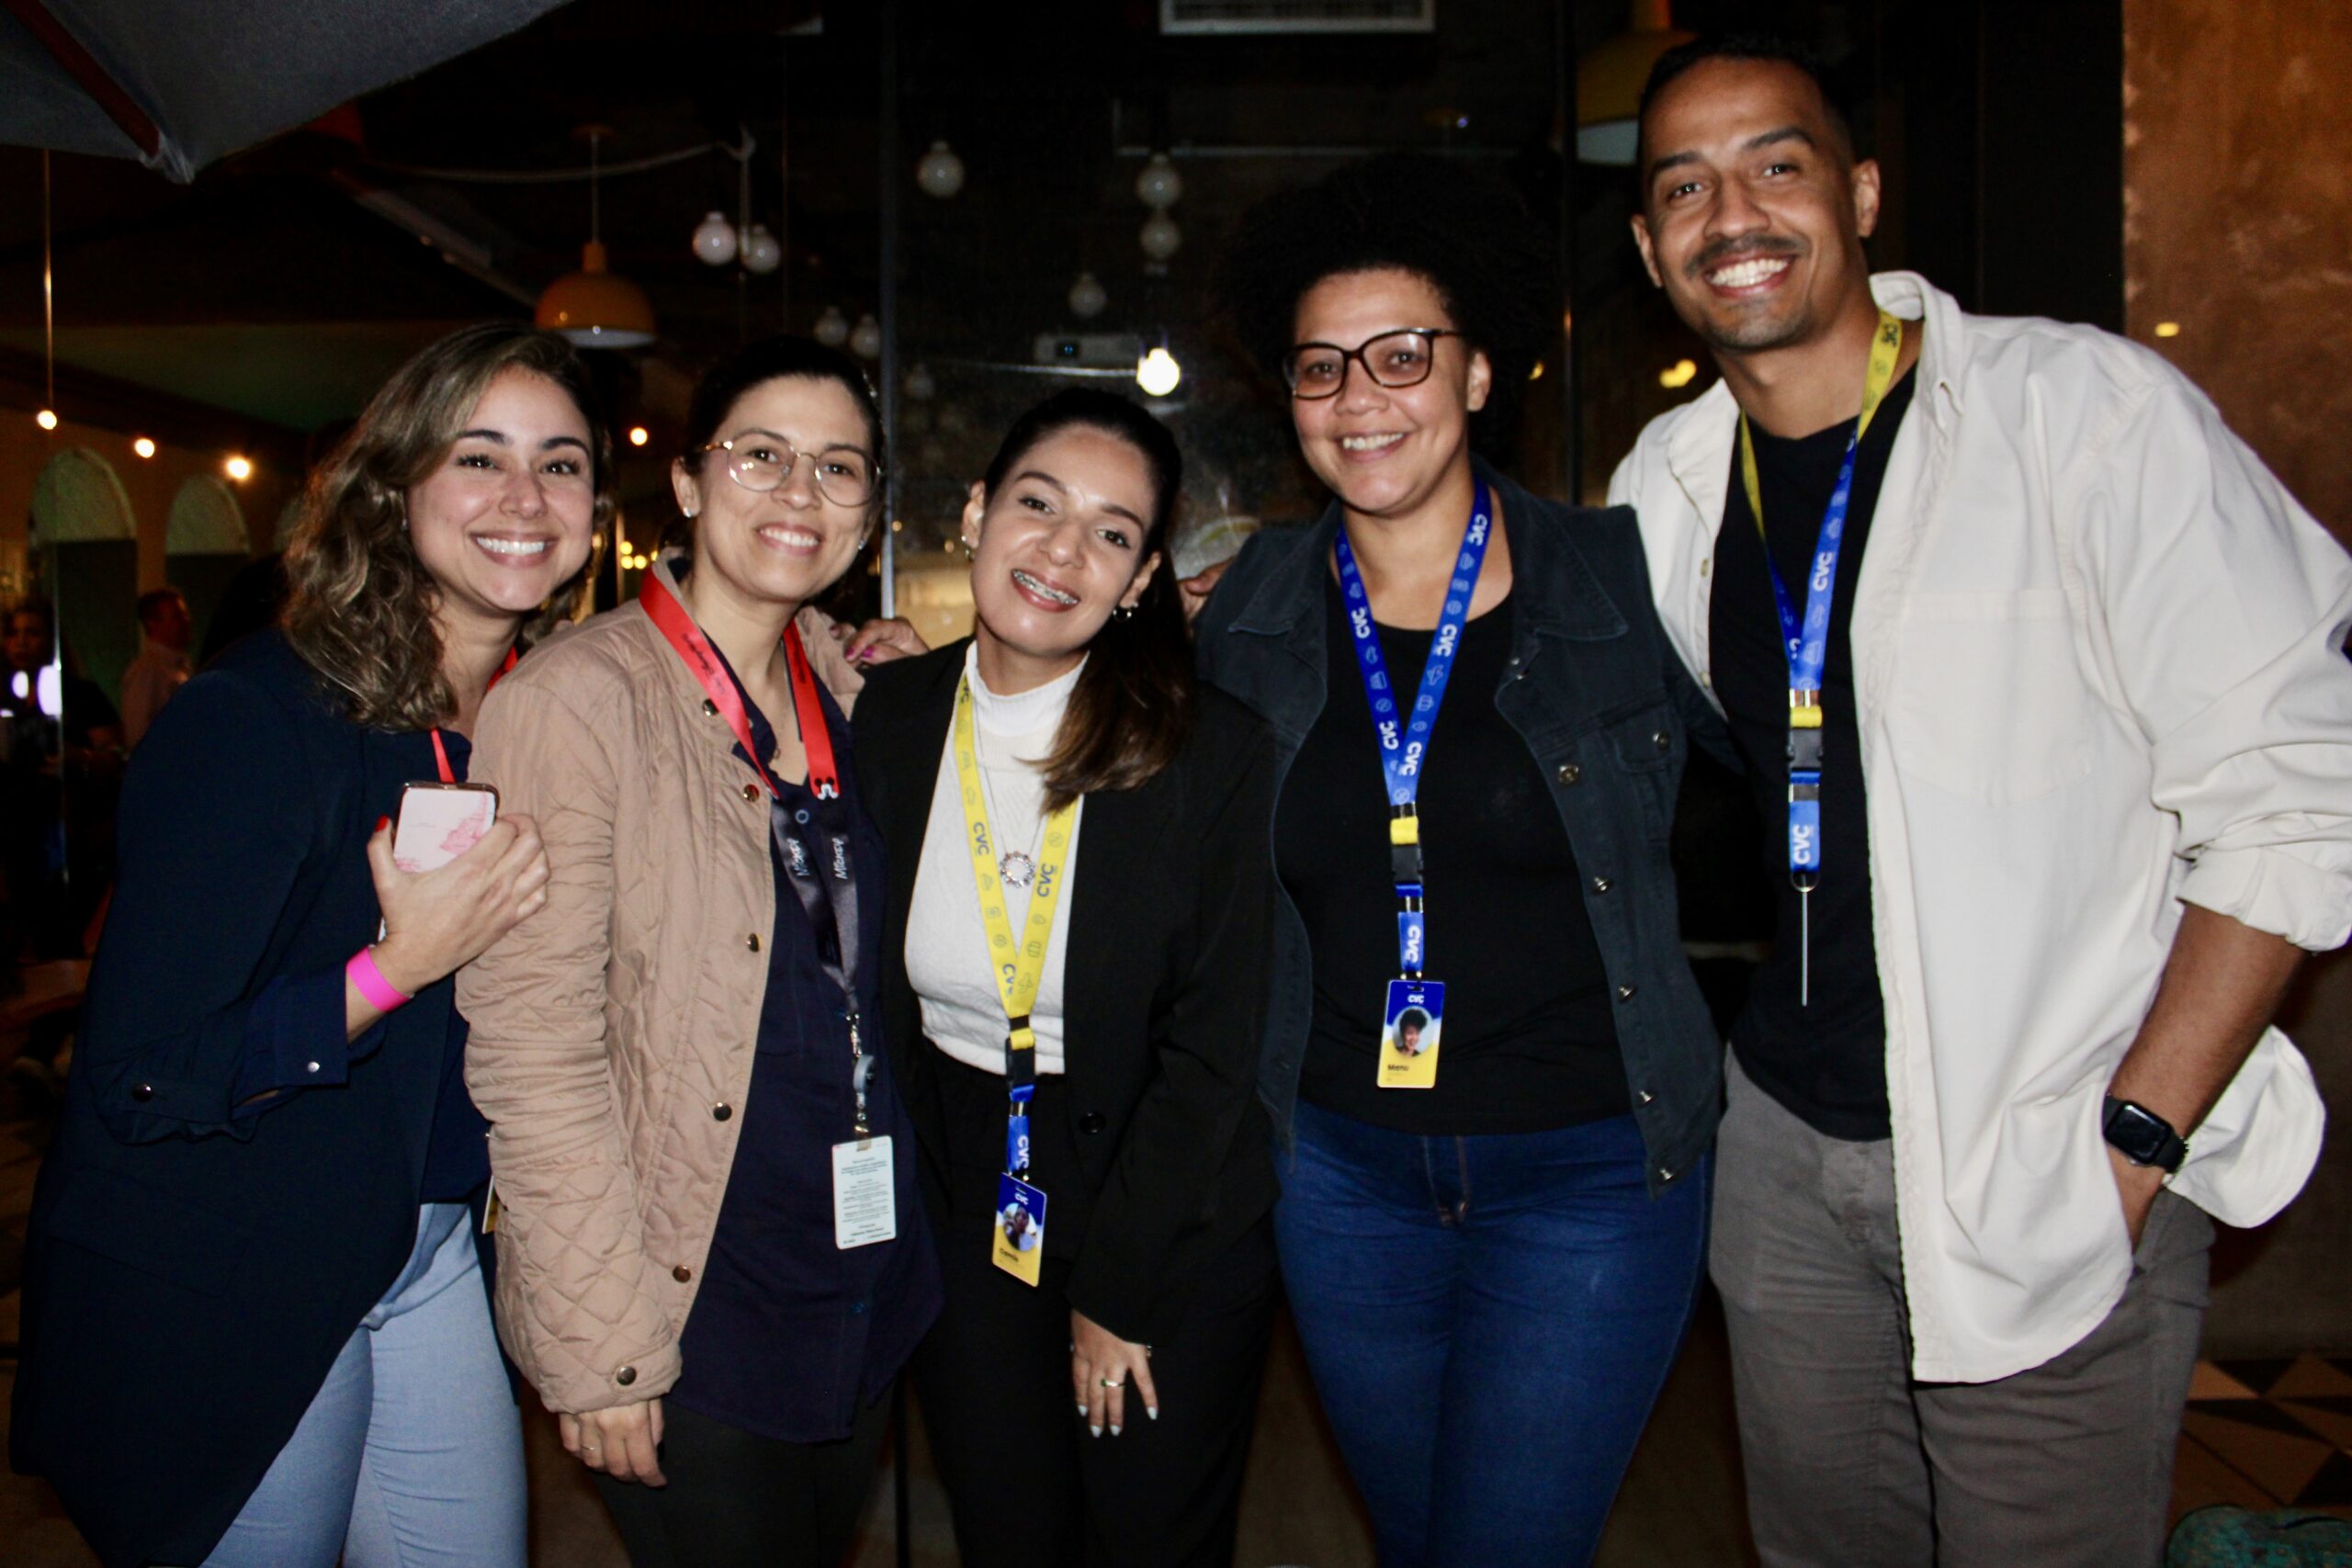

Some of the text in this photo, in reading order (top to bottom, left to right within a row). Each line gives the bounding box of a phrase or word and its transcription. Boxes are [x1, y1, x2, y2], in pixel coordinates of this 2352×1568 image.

[1468, 513, 1487, 546] CVC
[1813, 552, 1833, 592] CVC
[1351, 607, 1370, 638] CVC
[1436, 624, 1457, 657] CVC
[1379, 721, 1399, 750] CVC
[1400, 741, 1422, 776] CVC
[974, 822, 989, 855] CVC
[1792, 824, 1811, 864] CVC
[1036, 863, 1055, 897] CVC
[1405, 925, 1421, 963] CVC
[1002, 964, 1015, 995] CV
[1408, 994, 1424, 1004] CVC
[1017, 1135, 1029, 1168] CVC
